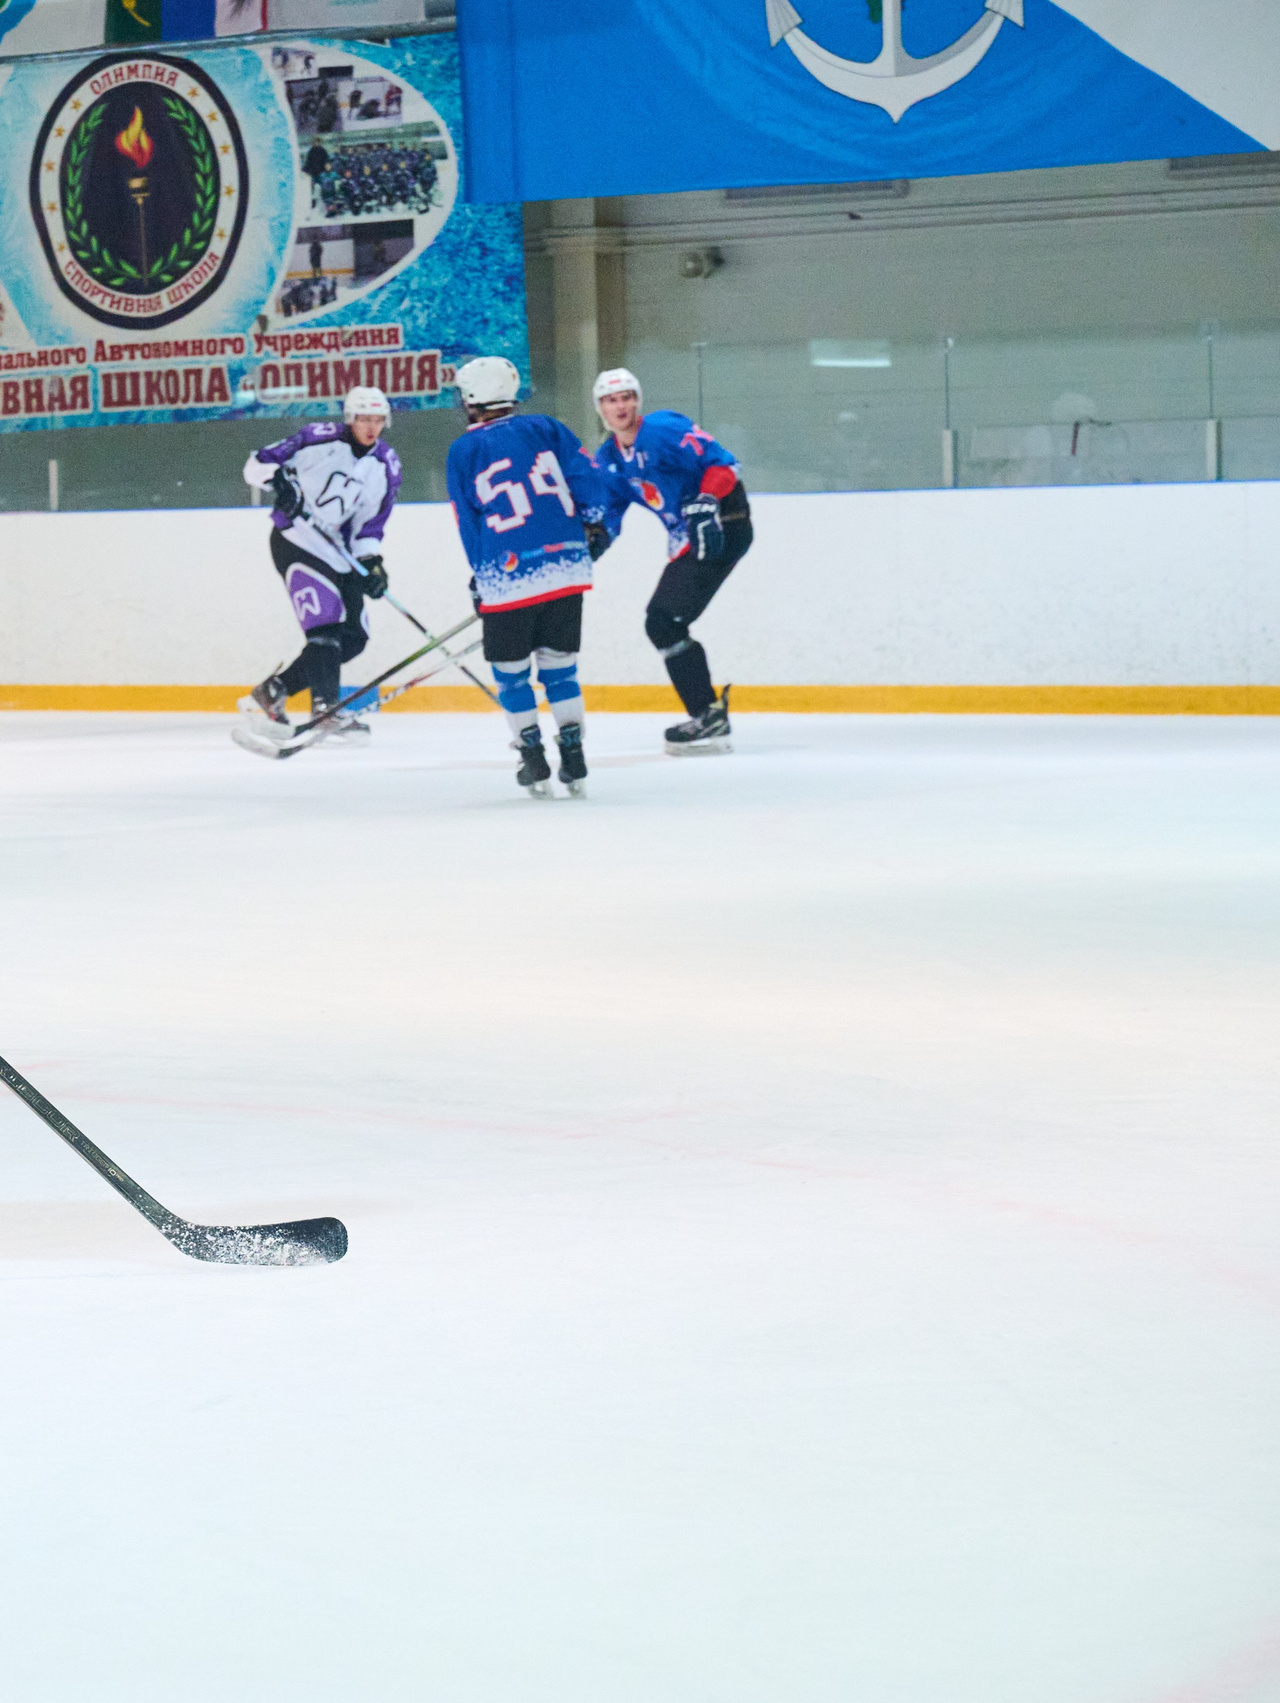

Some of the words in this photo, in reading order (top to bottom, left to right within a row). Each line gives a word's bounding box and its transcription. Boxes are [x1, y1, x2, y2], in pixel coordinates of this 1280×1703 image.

[89, 63, 179, 96] ОЛИМПИЯ
[64, 259, 164, 313] СПОРТИВНАЯ
[165, 251, 220, 305] ШКОЛА
[93, 335, 246, 362] Автономного
[100, 364, 231, 408] ШКОЛА
[474, 450, 576, 534] 54
